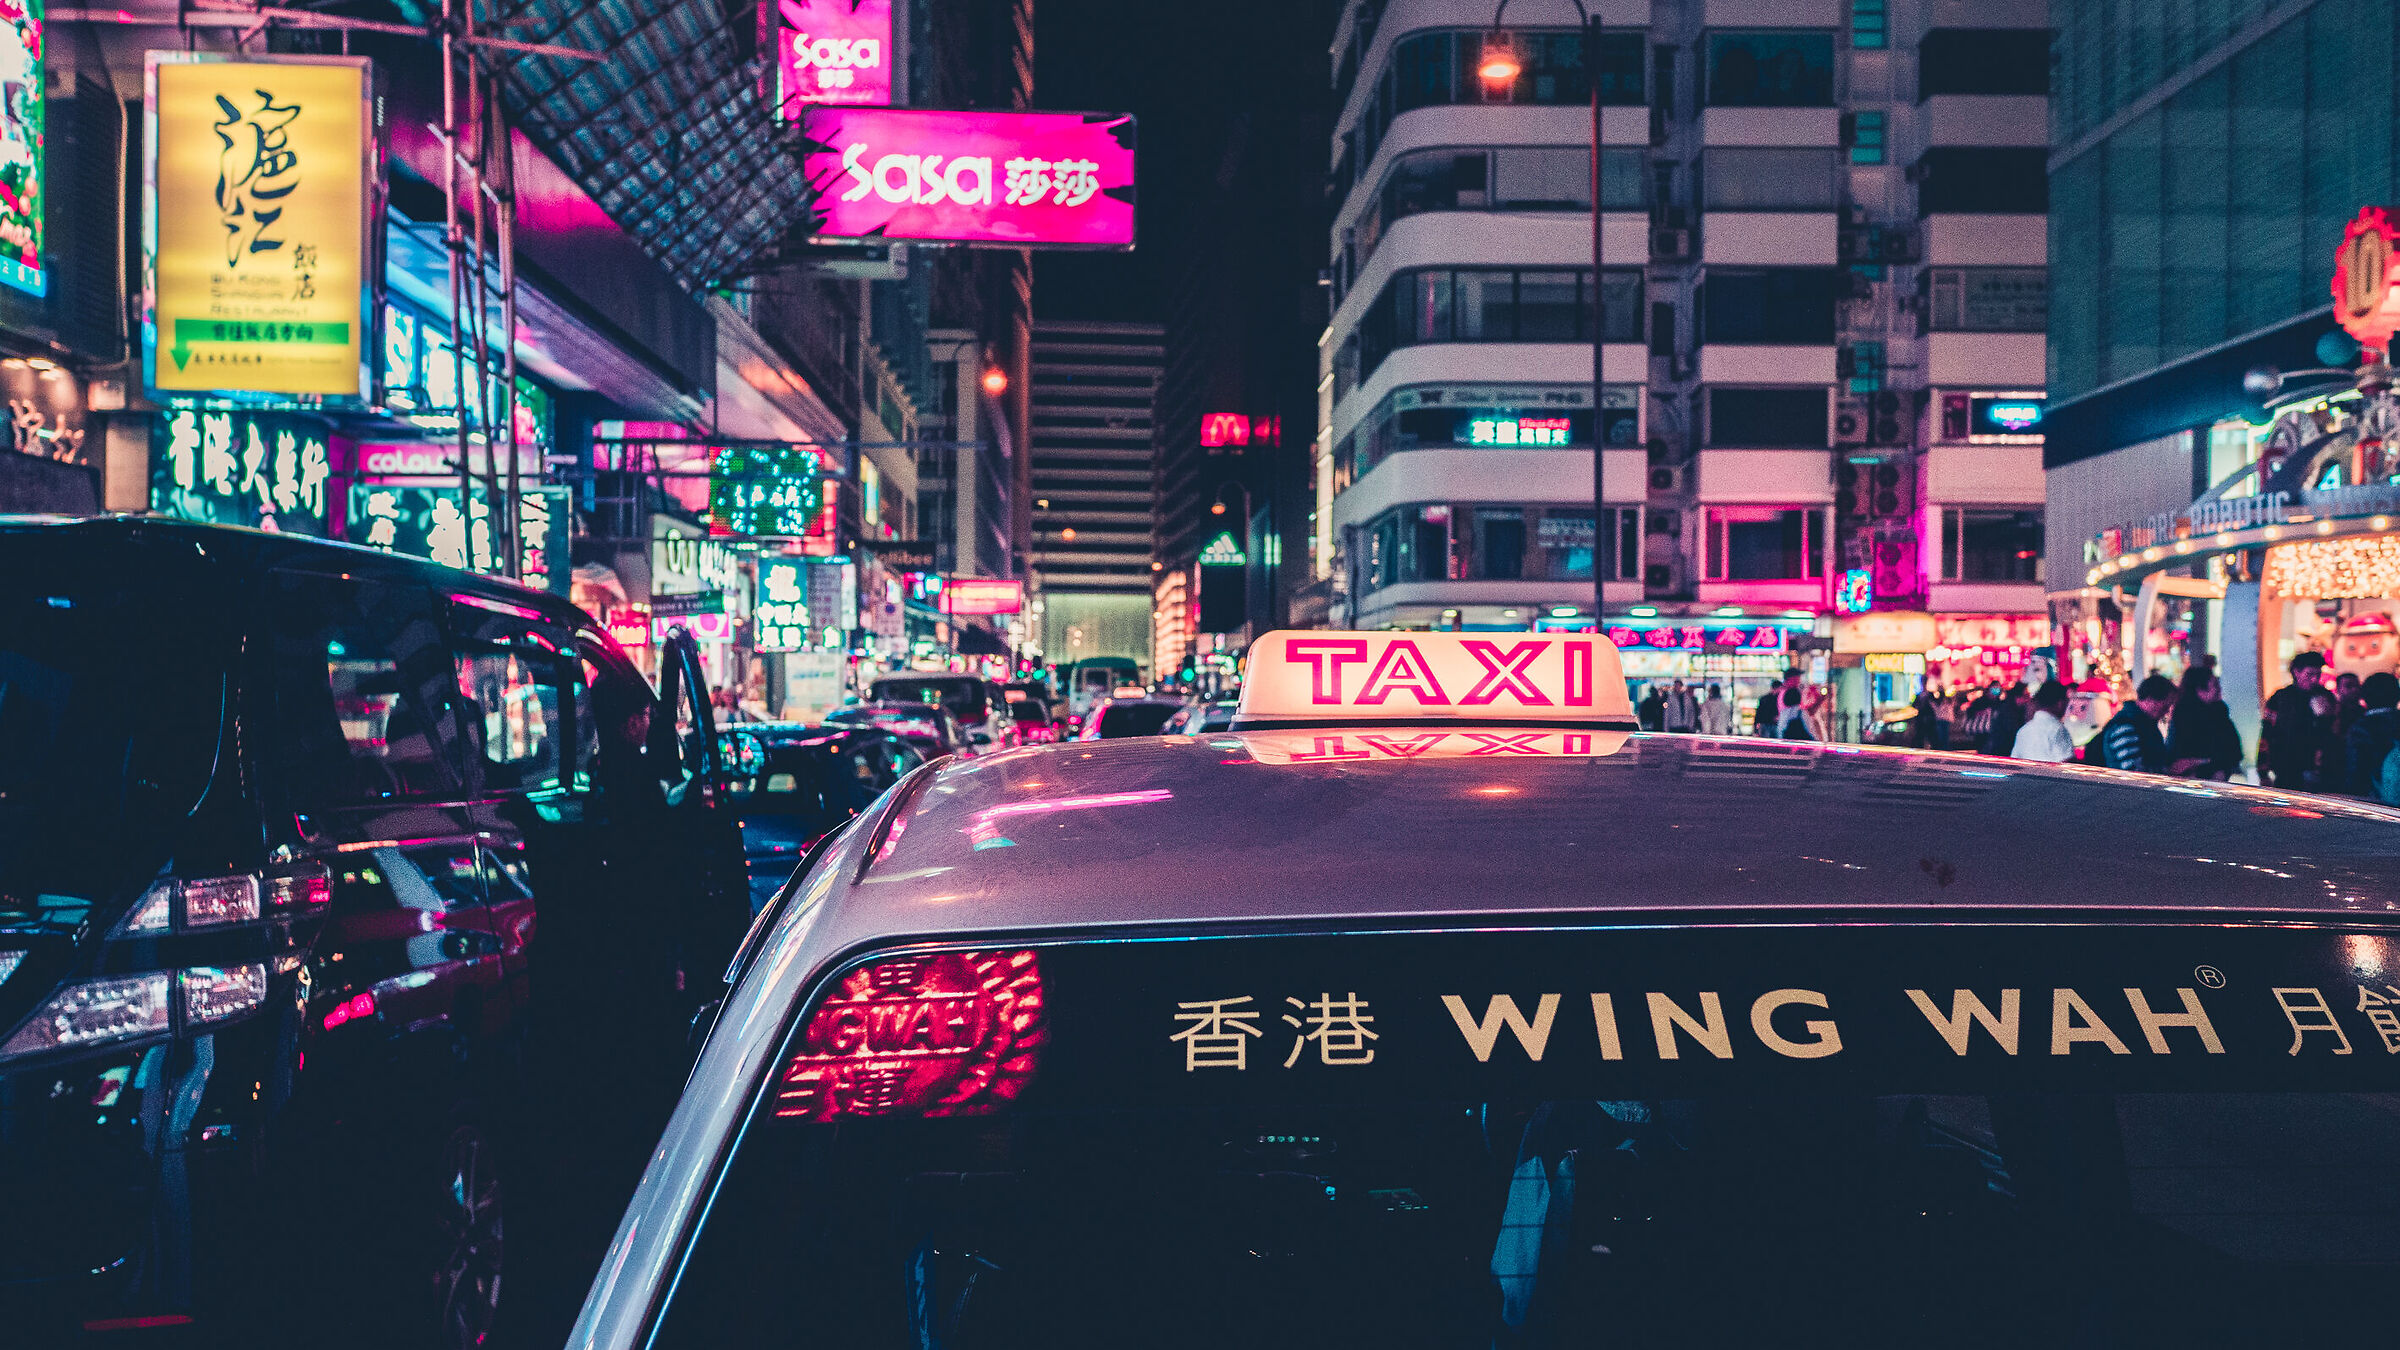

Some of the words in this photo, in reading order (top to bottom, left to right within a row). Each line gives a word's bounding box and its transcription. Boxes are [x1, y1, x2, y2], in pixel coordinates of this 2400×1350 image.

[841, 142, 992, 206] Sasa
[1004, 157, 1100, 208] 莎莎
[1286, 639, 1592, 706] TAXI
[1169, 991, 1380, 1072] 香港
[1441, 988, 1843, 1062] WING
[1904, 987, 2226, 1057] WAH
